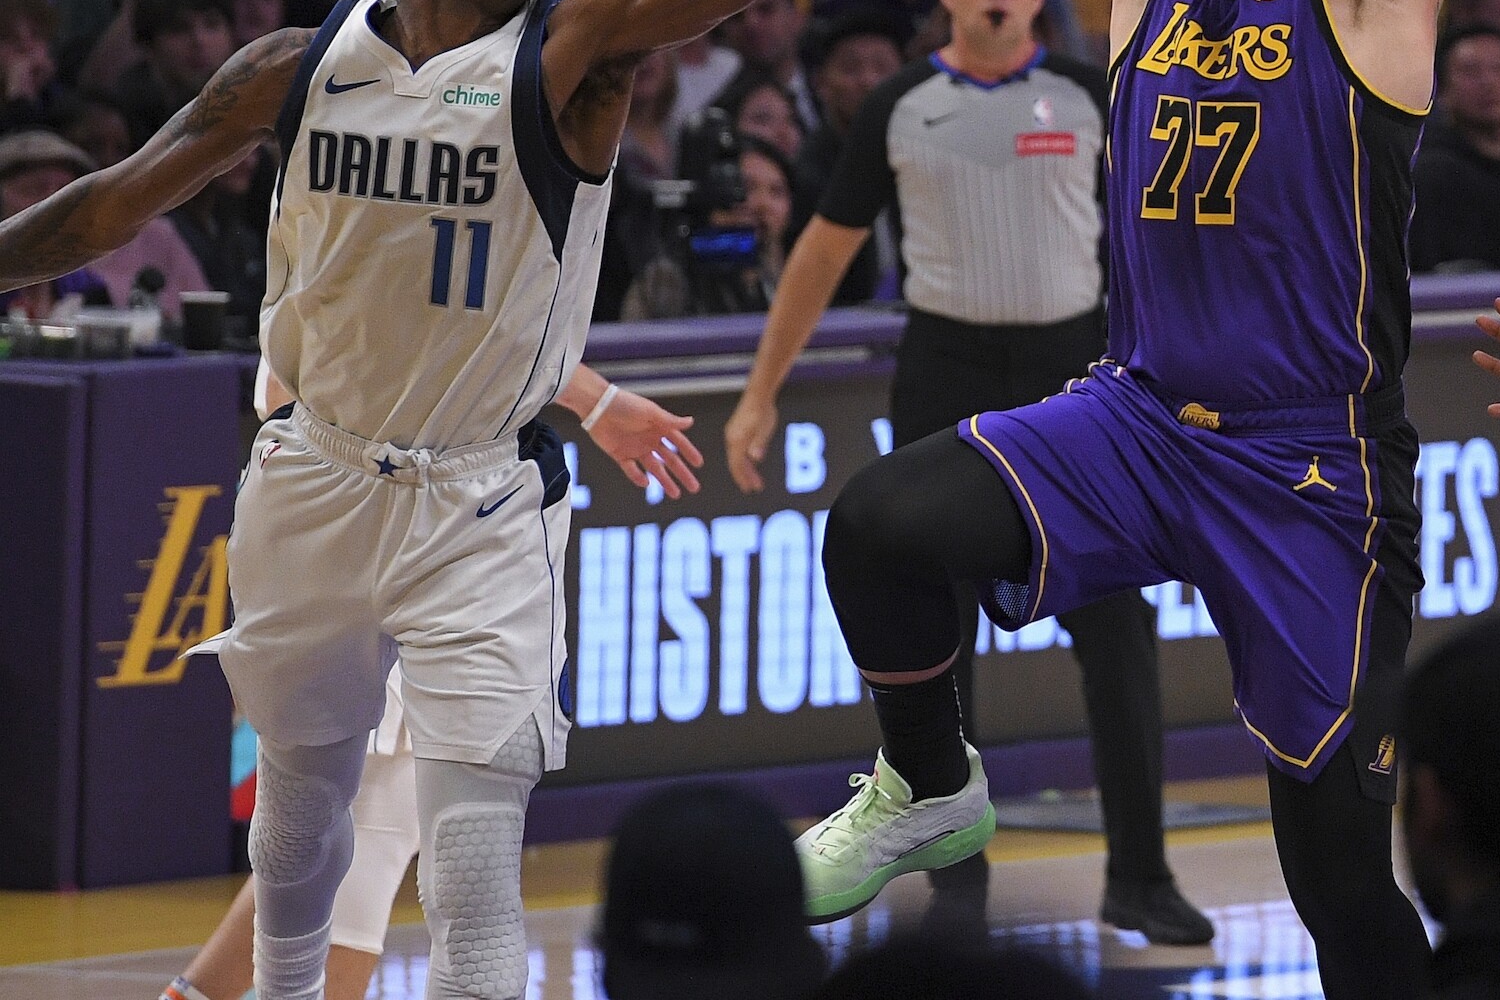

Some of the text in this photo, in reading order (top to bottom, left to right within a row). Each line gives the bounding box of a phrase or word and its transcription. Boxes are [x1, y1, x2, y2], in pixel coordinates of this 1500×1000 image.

[1136, 2, 1293, 81] LAKERS
[443, 85, 501, 106] chime
[308, 128, 500, 206] DALLAS
[1140, 94, 1261, 225] 77
[429, 216, 492, 311] 11
